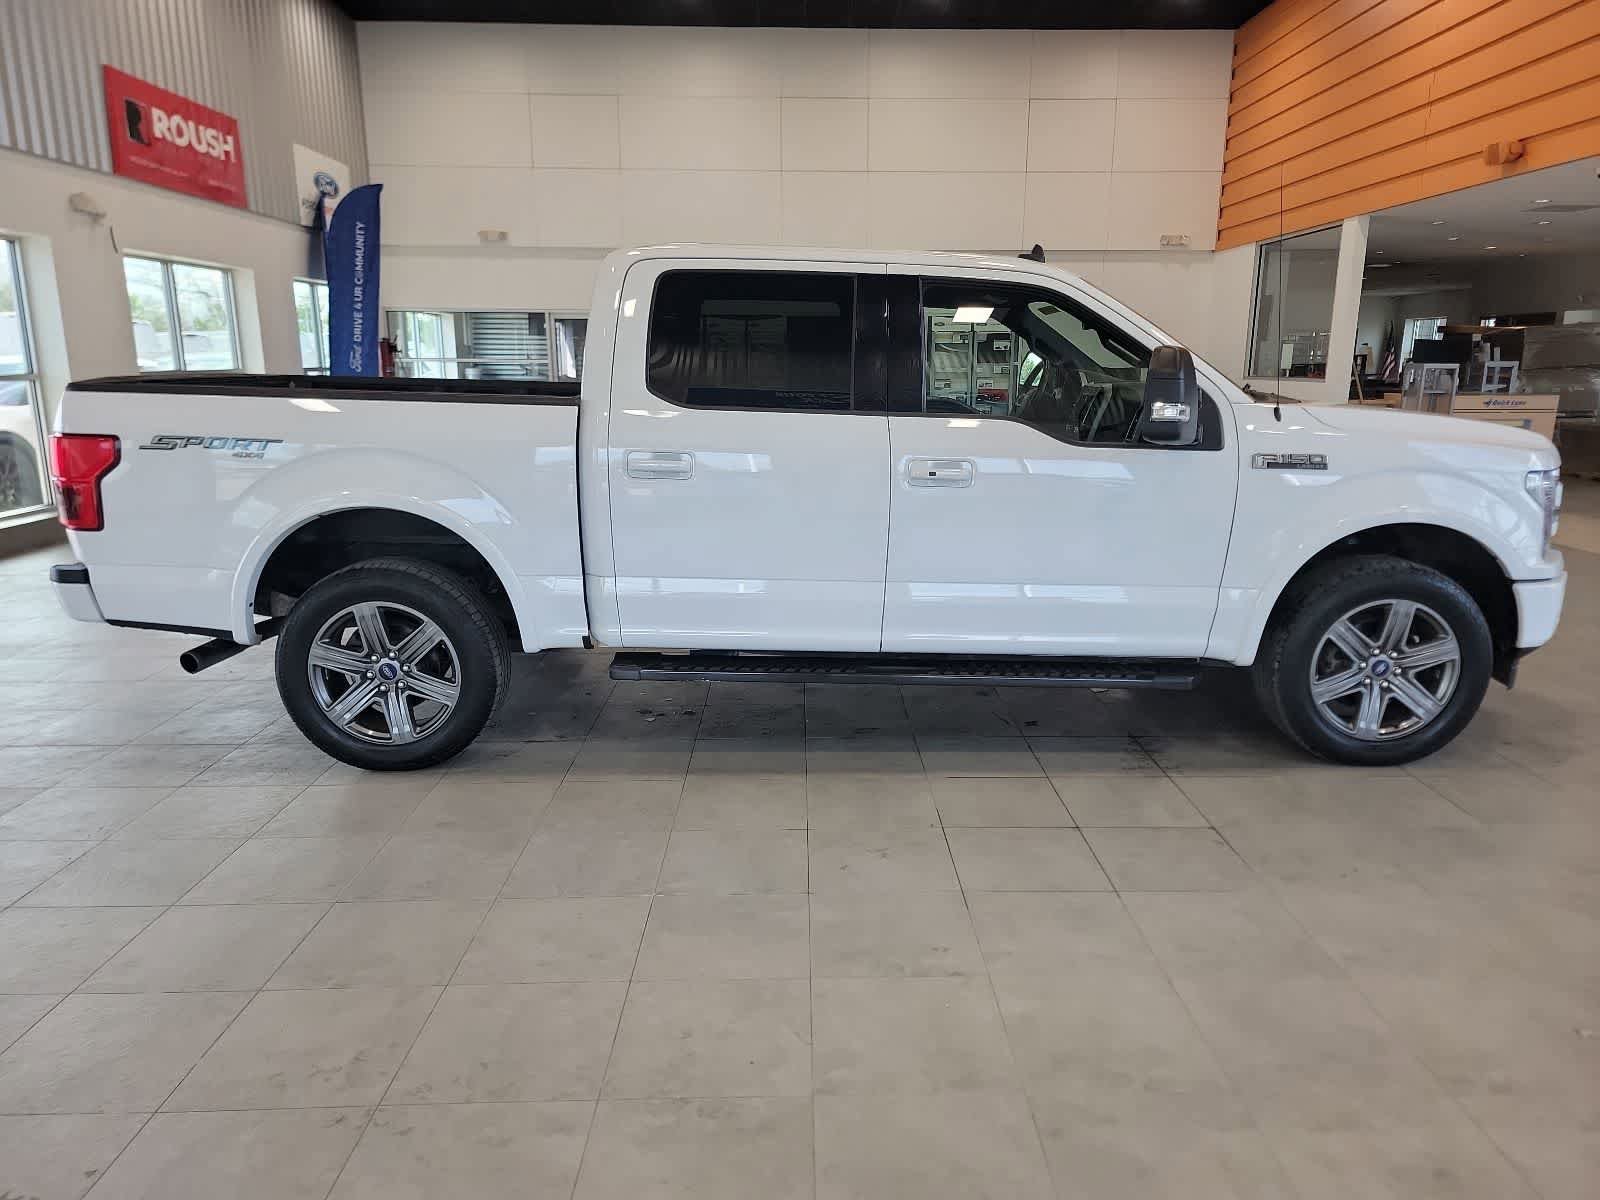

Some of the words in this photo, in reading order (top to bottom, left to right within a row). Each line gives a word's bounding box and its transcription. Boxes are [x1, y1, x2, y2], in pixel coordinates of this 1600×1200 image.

[151, 106, 236, 163] ROUSH
[354, 221, 367, 284] COMMUNITY
[354, 287, 364, 301] UR
[352, 311, 363, 341] DRIVE
[349, 345, 362, 373] Ford
[138, 434, 284, 451] SPORT
